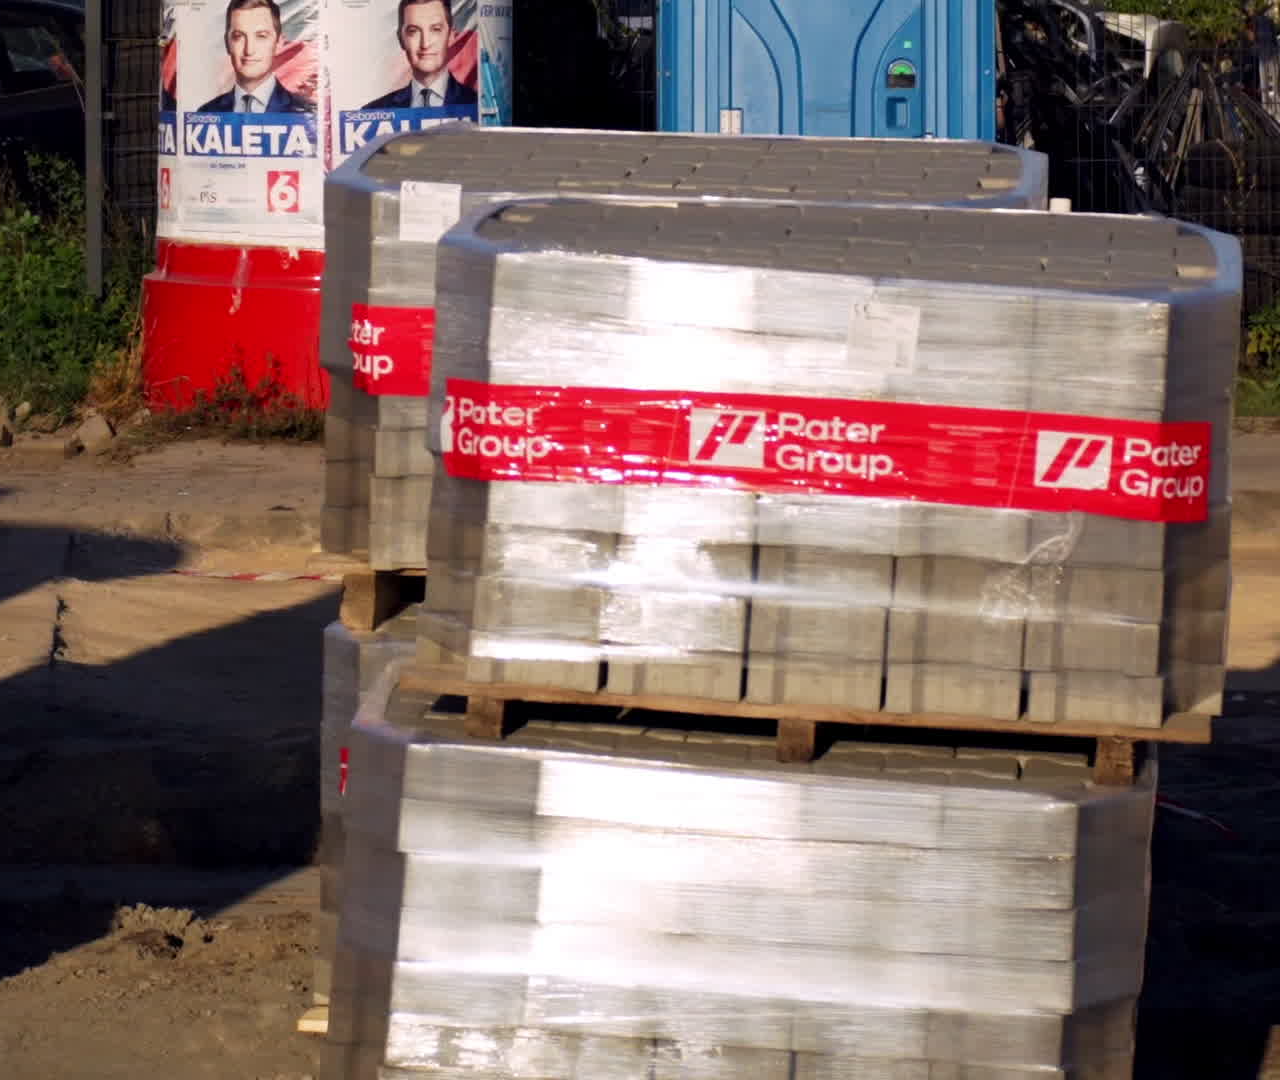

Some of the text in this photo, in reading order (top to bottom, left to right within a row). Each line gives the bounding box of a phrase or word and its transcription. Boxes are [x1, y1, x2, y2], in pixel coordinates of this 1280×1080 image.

[345, 111, 395, 121] Sebastian
[186, 123, 312, 155] KALETA
[270, 173, 298, 210] 6
[352, 319, 385, 347] ter
[353, 352, 394, 381] oup
[459, 397, 540, 425] Pater
[776, 412, 886, 445] Pater
[457, 431, 552, 464] Group
[775, 444, 894, 482] Group
[1123, 438, 1201, 467] Pater
[1120, 468, 1204, 504] Group
